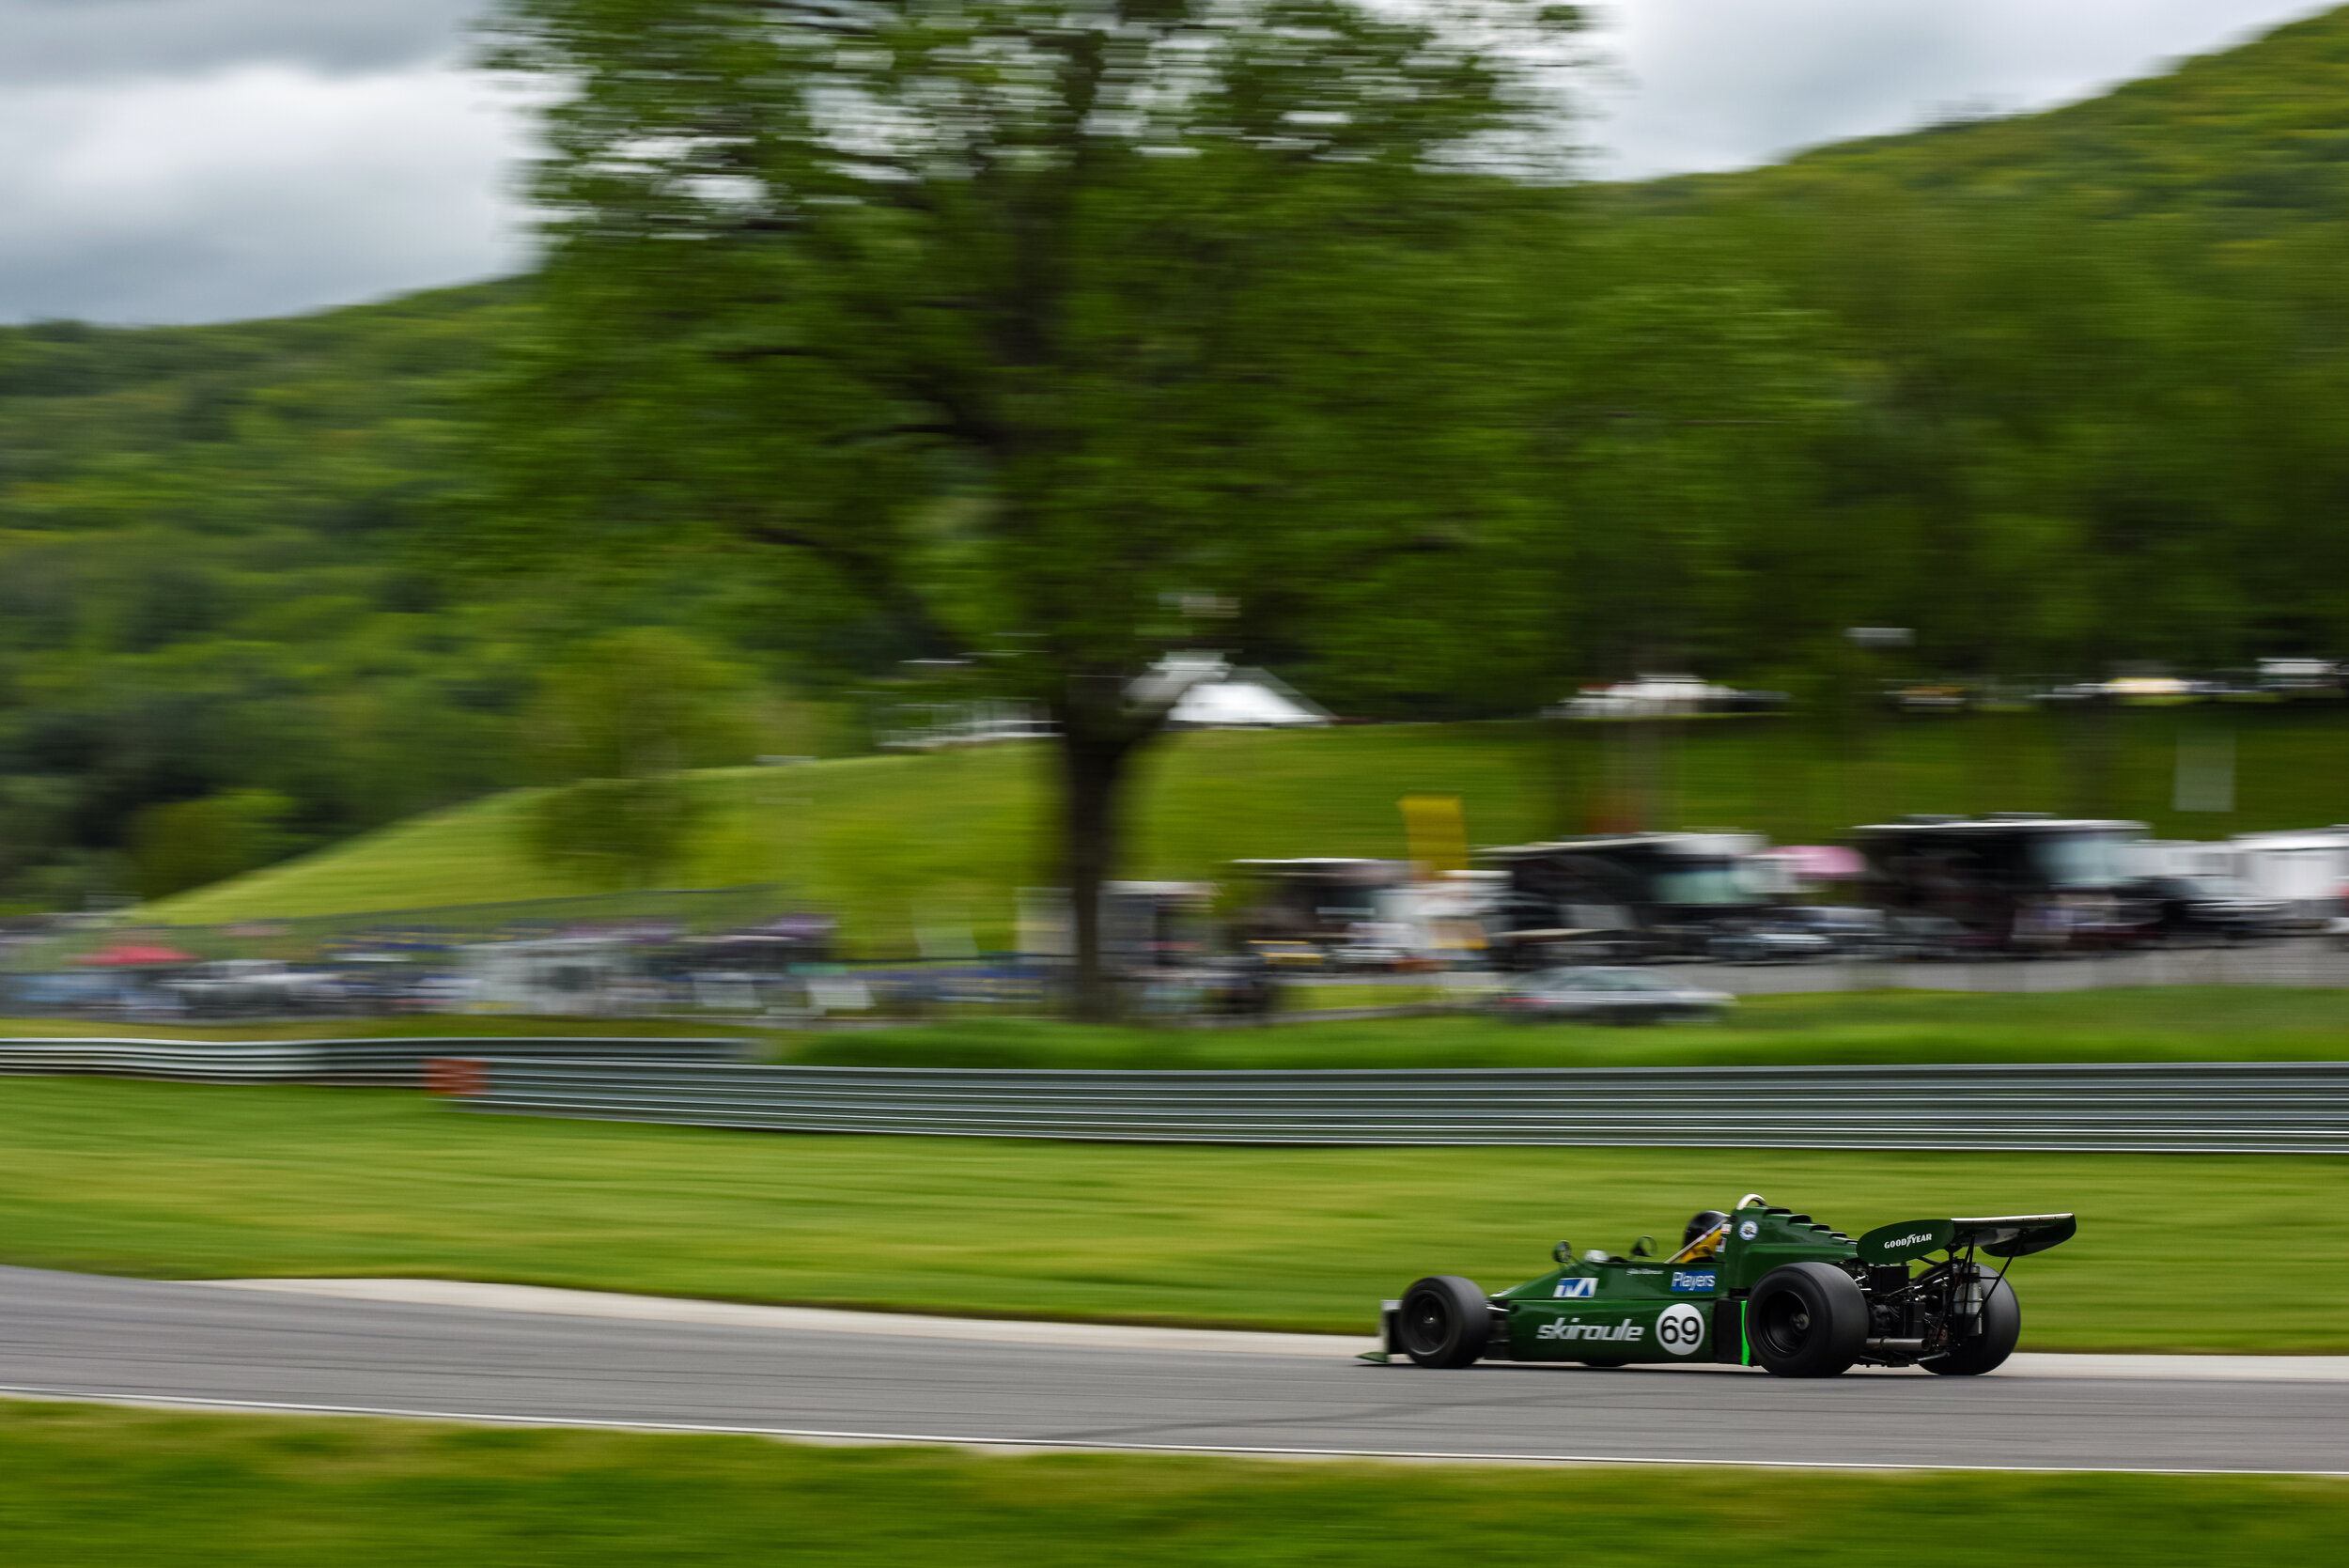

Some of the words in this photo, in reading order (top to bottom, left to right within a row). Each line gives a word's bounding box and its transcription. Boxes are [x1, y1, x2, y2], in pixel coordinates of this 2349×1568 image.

[1884, 1234, 1932, 1249] GOODYEAR
[1672, 1271, 1717, 1291] Players
[1537, 1317, 1644, 1341] skiroule
[1661, 1315, 1700, 1344] 69
